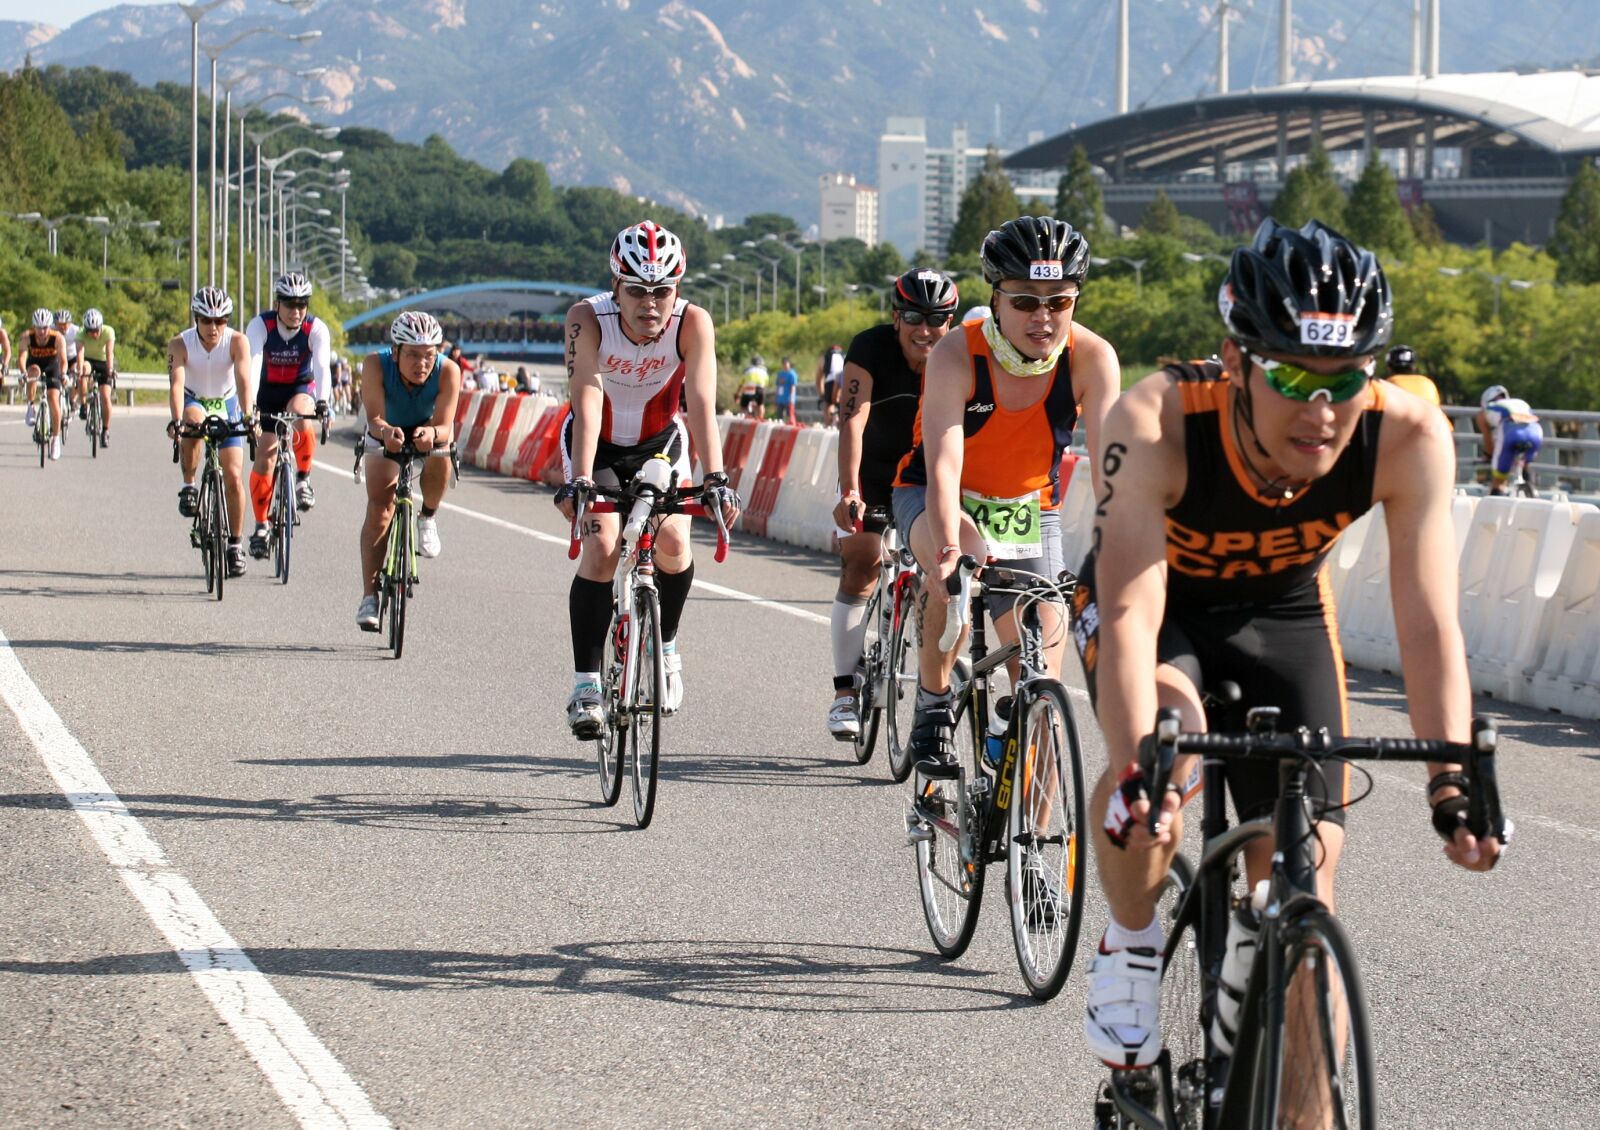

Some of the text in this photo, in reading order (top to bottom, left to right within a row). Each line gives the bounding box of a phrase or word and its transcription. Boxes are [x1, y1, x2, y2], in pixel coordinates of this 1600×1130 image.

[642, 264, 662, 273] 345
[1033, 266, 1060, 277] 439
[1307, 322, 1348, 342] 629
[567, 323, 581, 378] 345
[583, 520, 602, 536] 45
[974, 503, 1032, 536] 439
[1166, 511, 1352, 557] OPEN
